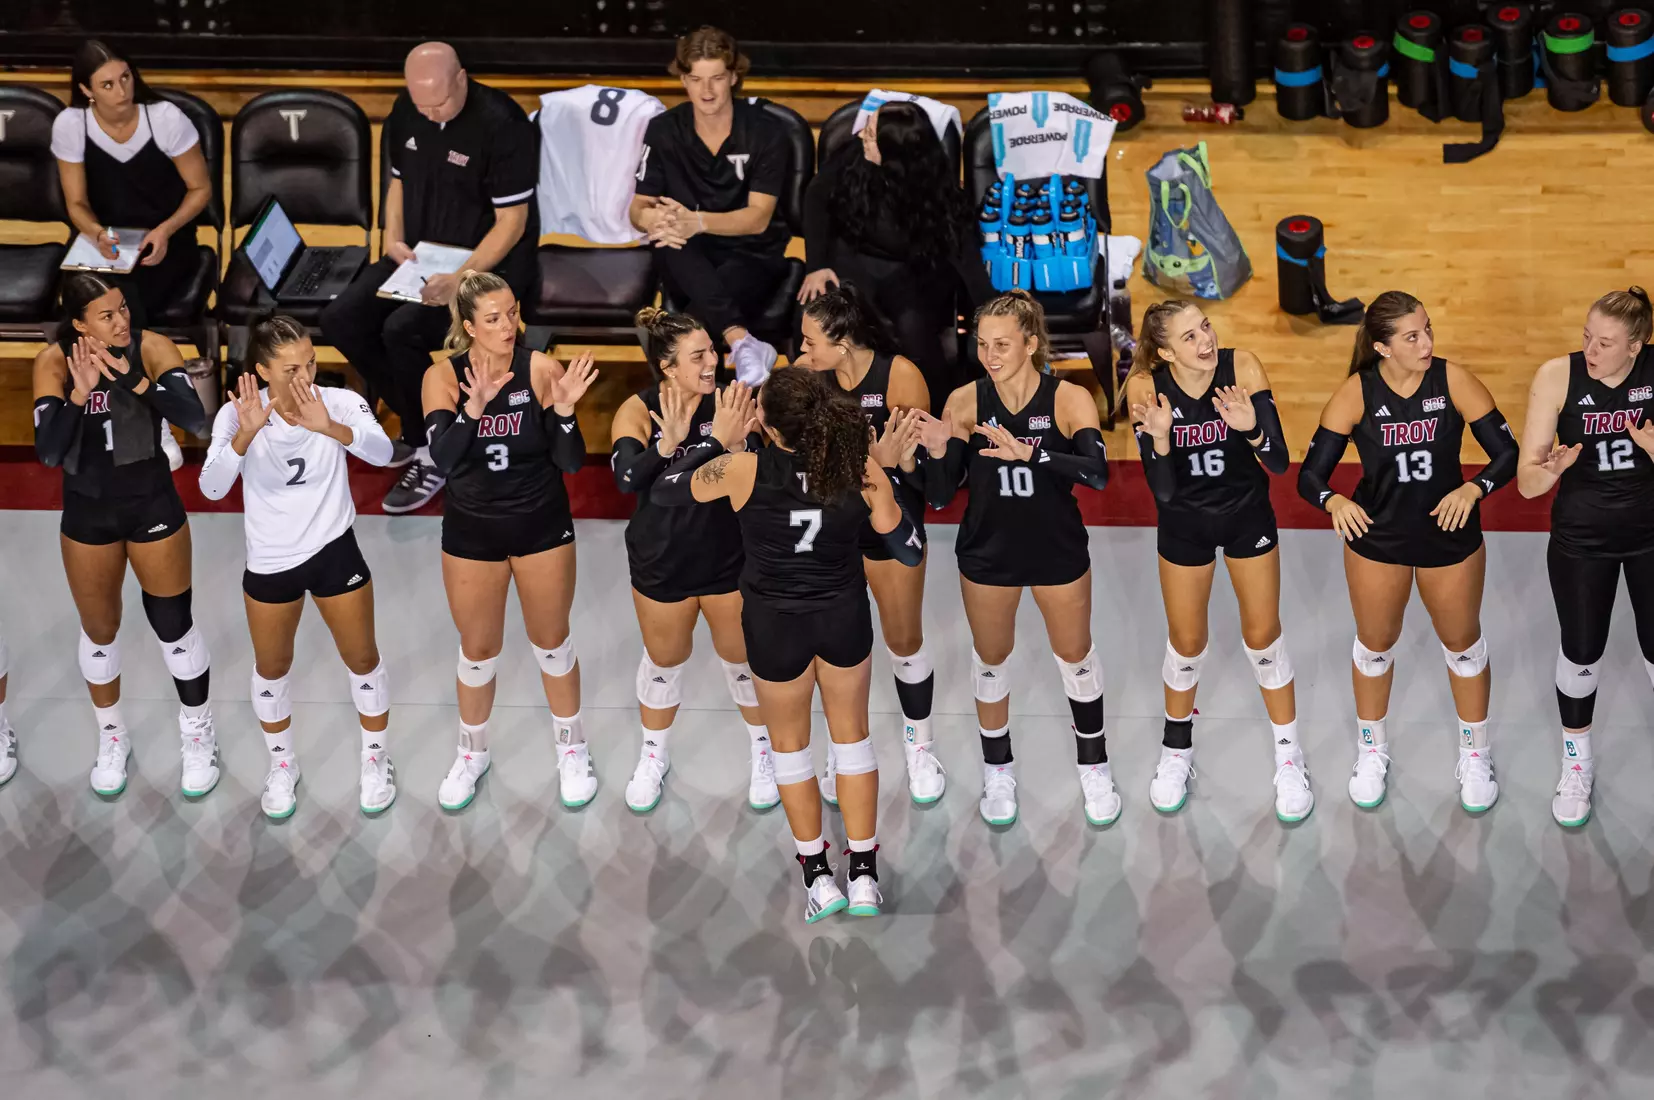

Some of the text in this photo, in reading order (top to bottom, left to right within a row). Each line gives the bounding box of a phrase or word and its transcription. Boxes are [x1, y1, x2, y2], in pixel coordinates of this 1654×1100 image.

[590, 88, 627, 126] 8
[1627, 385, 1653, 402] SBC
[477, 411, 523, 437] ROY
[1173, 418, 1229, 448] TROY
[1381, 417, 1438, 446] TROY
[1582, 407, 1644, 435] TROY
[485, 443, 509, 472] 3
[1188, 449, 1226, 477] 16
[1395, 449, 1433, 483] 13
[1595, 438, 1636, 471] 12
[286, 457, 307, 487] 2
[997, 464, 1035, 493] 10
[789, 508, 823, 554] 7
